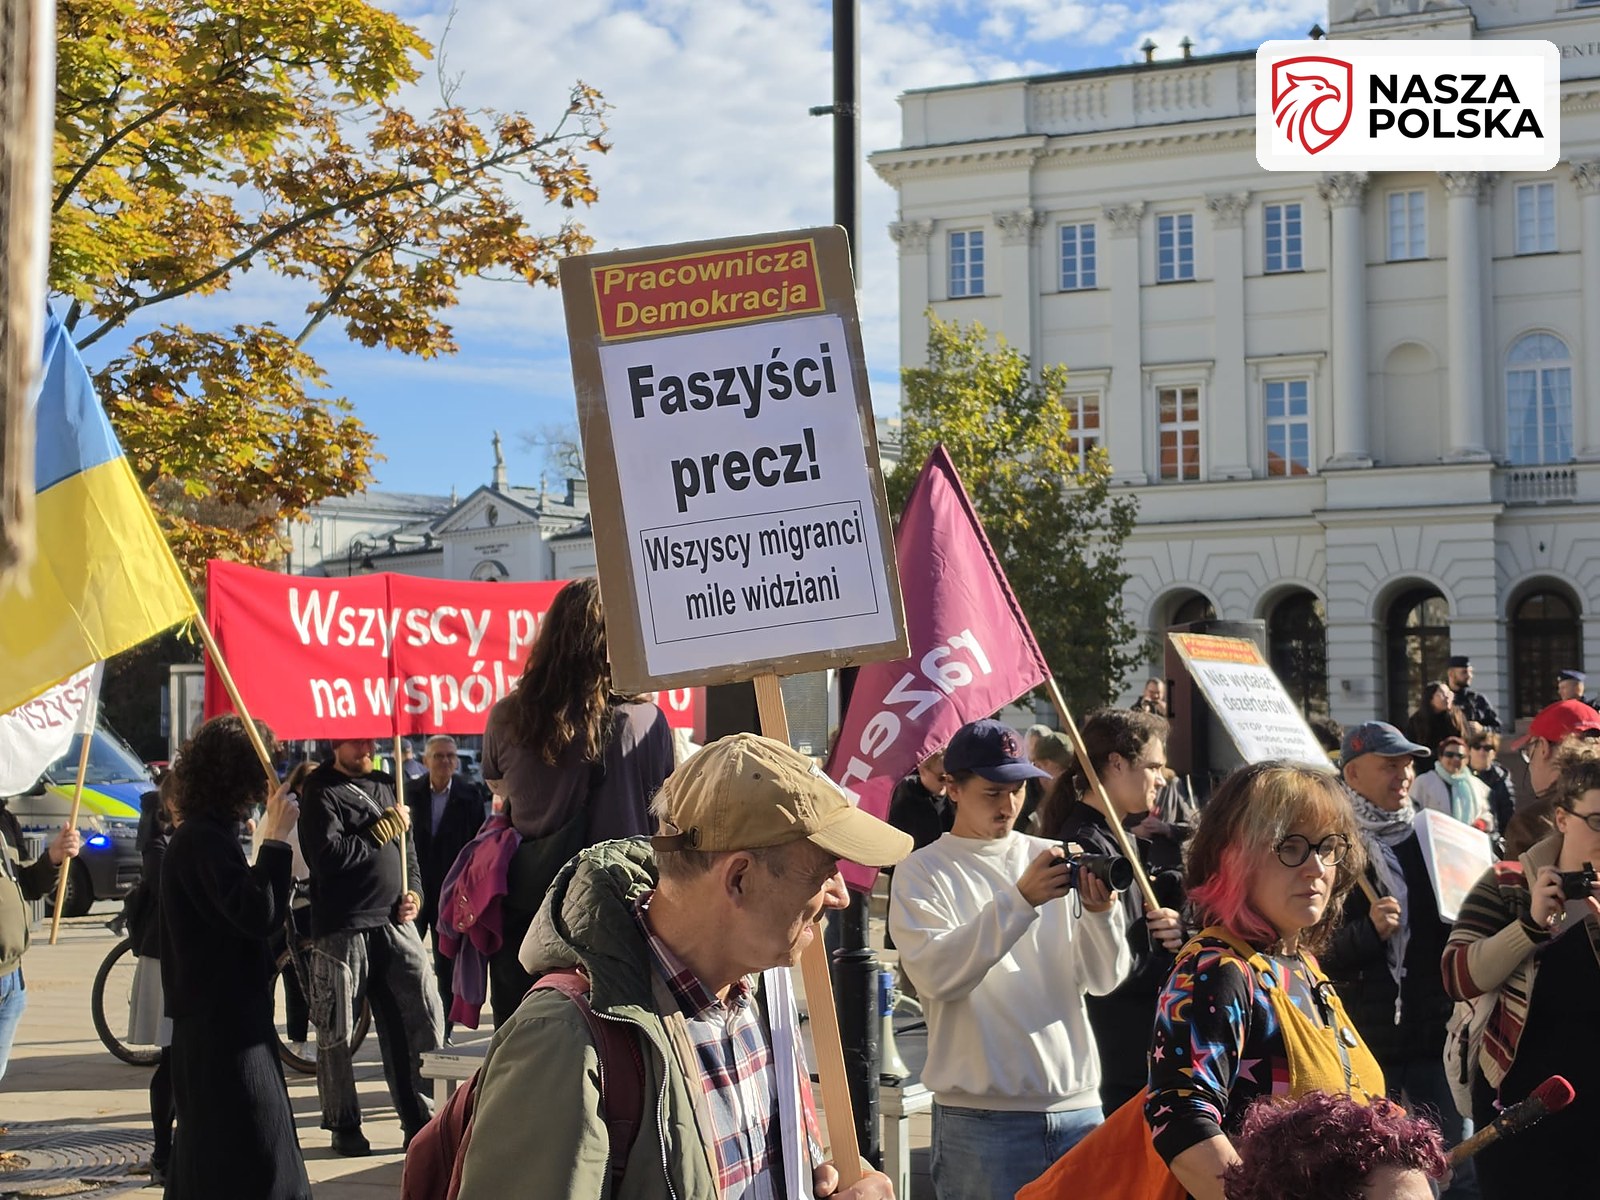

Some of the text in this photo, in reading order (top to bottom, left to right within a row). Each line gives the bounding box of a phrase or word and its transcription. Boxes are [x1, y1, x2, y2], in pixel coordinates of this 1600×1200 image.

[604, 250, 808, 295] Pracownicza
[616, 283, 807, 328] Demokracja
[627, 342, 837, 419] Faszyści
[671, 428, 821, 513] precz!
[645, 510, 862, 574] Wszyscy migranci
[288, 587, 491, 658] Wszyscy
[686, 566, 840, 620] mile widziani
[310, 677, 356, 718] na
[364, 660, 525, 727] wspól
[1203, 669, 1229, 687] Nie
